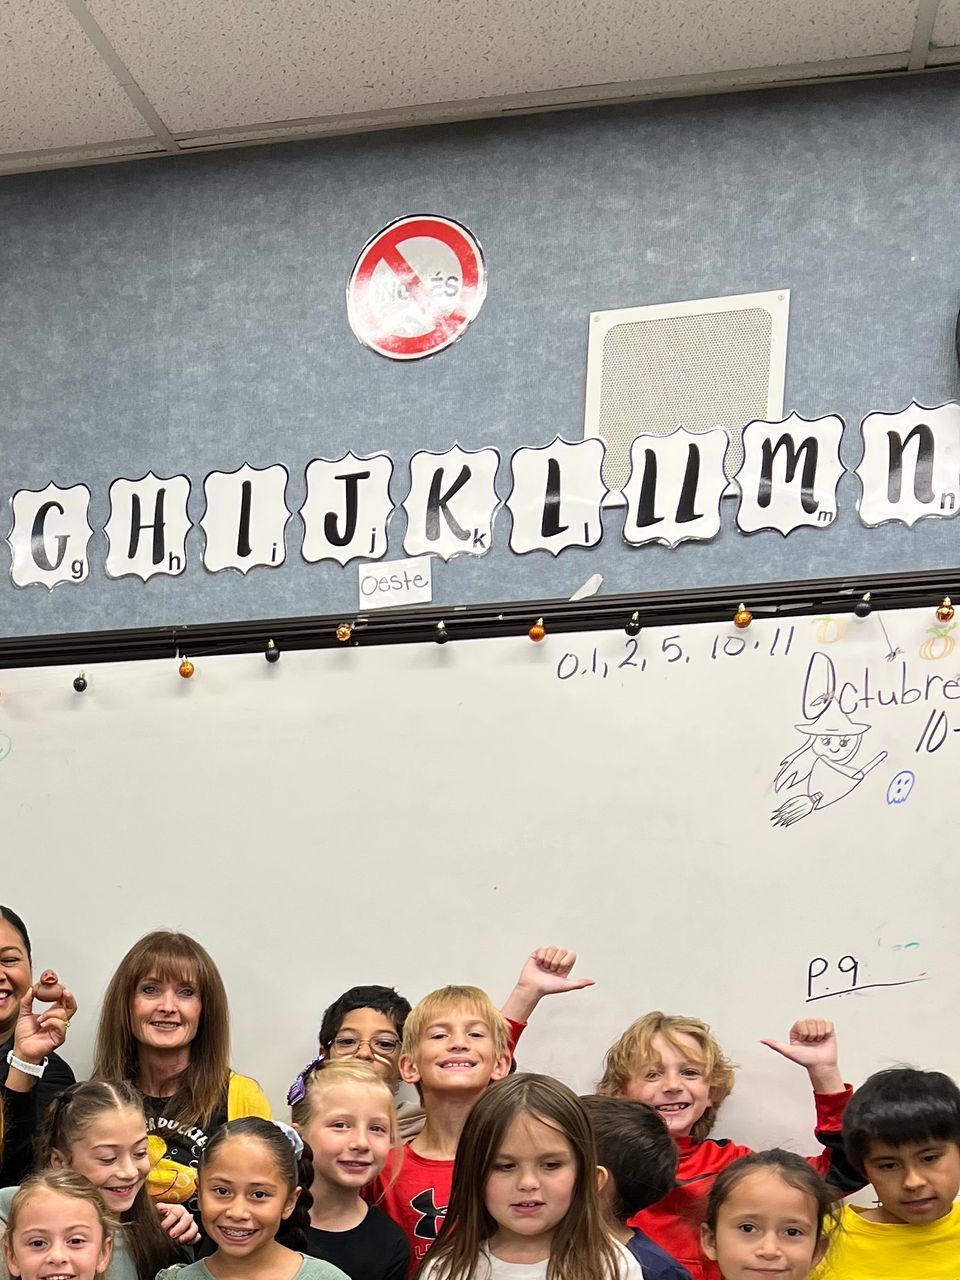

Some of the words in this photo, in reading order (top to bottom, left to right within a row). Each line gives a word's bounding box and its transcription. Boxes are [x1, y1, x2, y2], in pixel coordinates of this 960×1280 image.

[324, 471, 371, 547] J
[369, 528, 377, 553] j
[425, 464, 472, 541] K
[473, 527, 486, 549] k
[818, 510, 833, 522] m
[940, 492, 956, 509] n
[31, 500, 71, 571] G
[71, 559, 84, 579] g
[127, 487, 166, 565] H
[168, 551, 181, 571] h
[271, 542, 277, 562] i
[361, 571, 429, 595] Oeste
